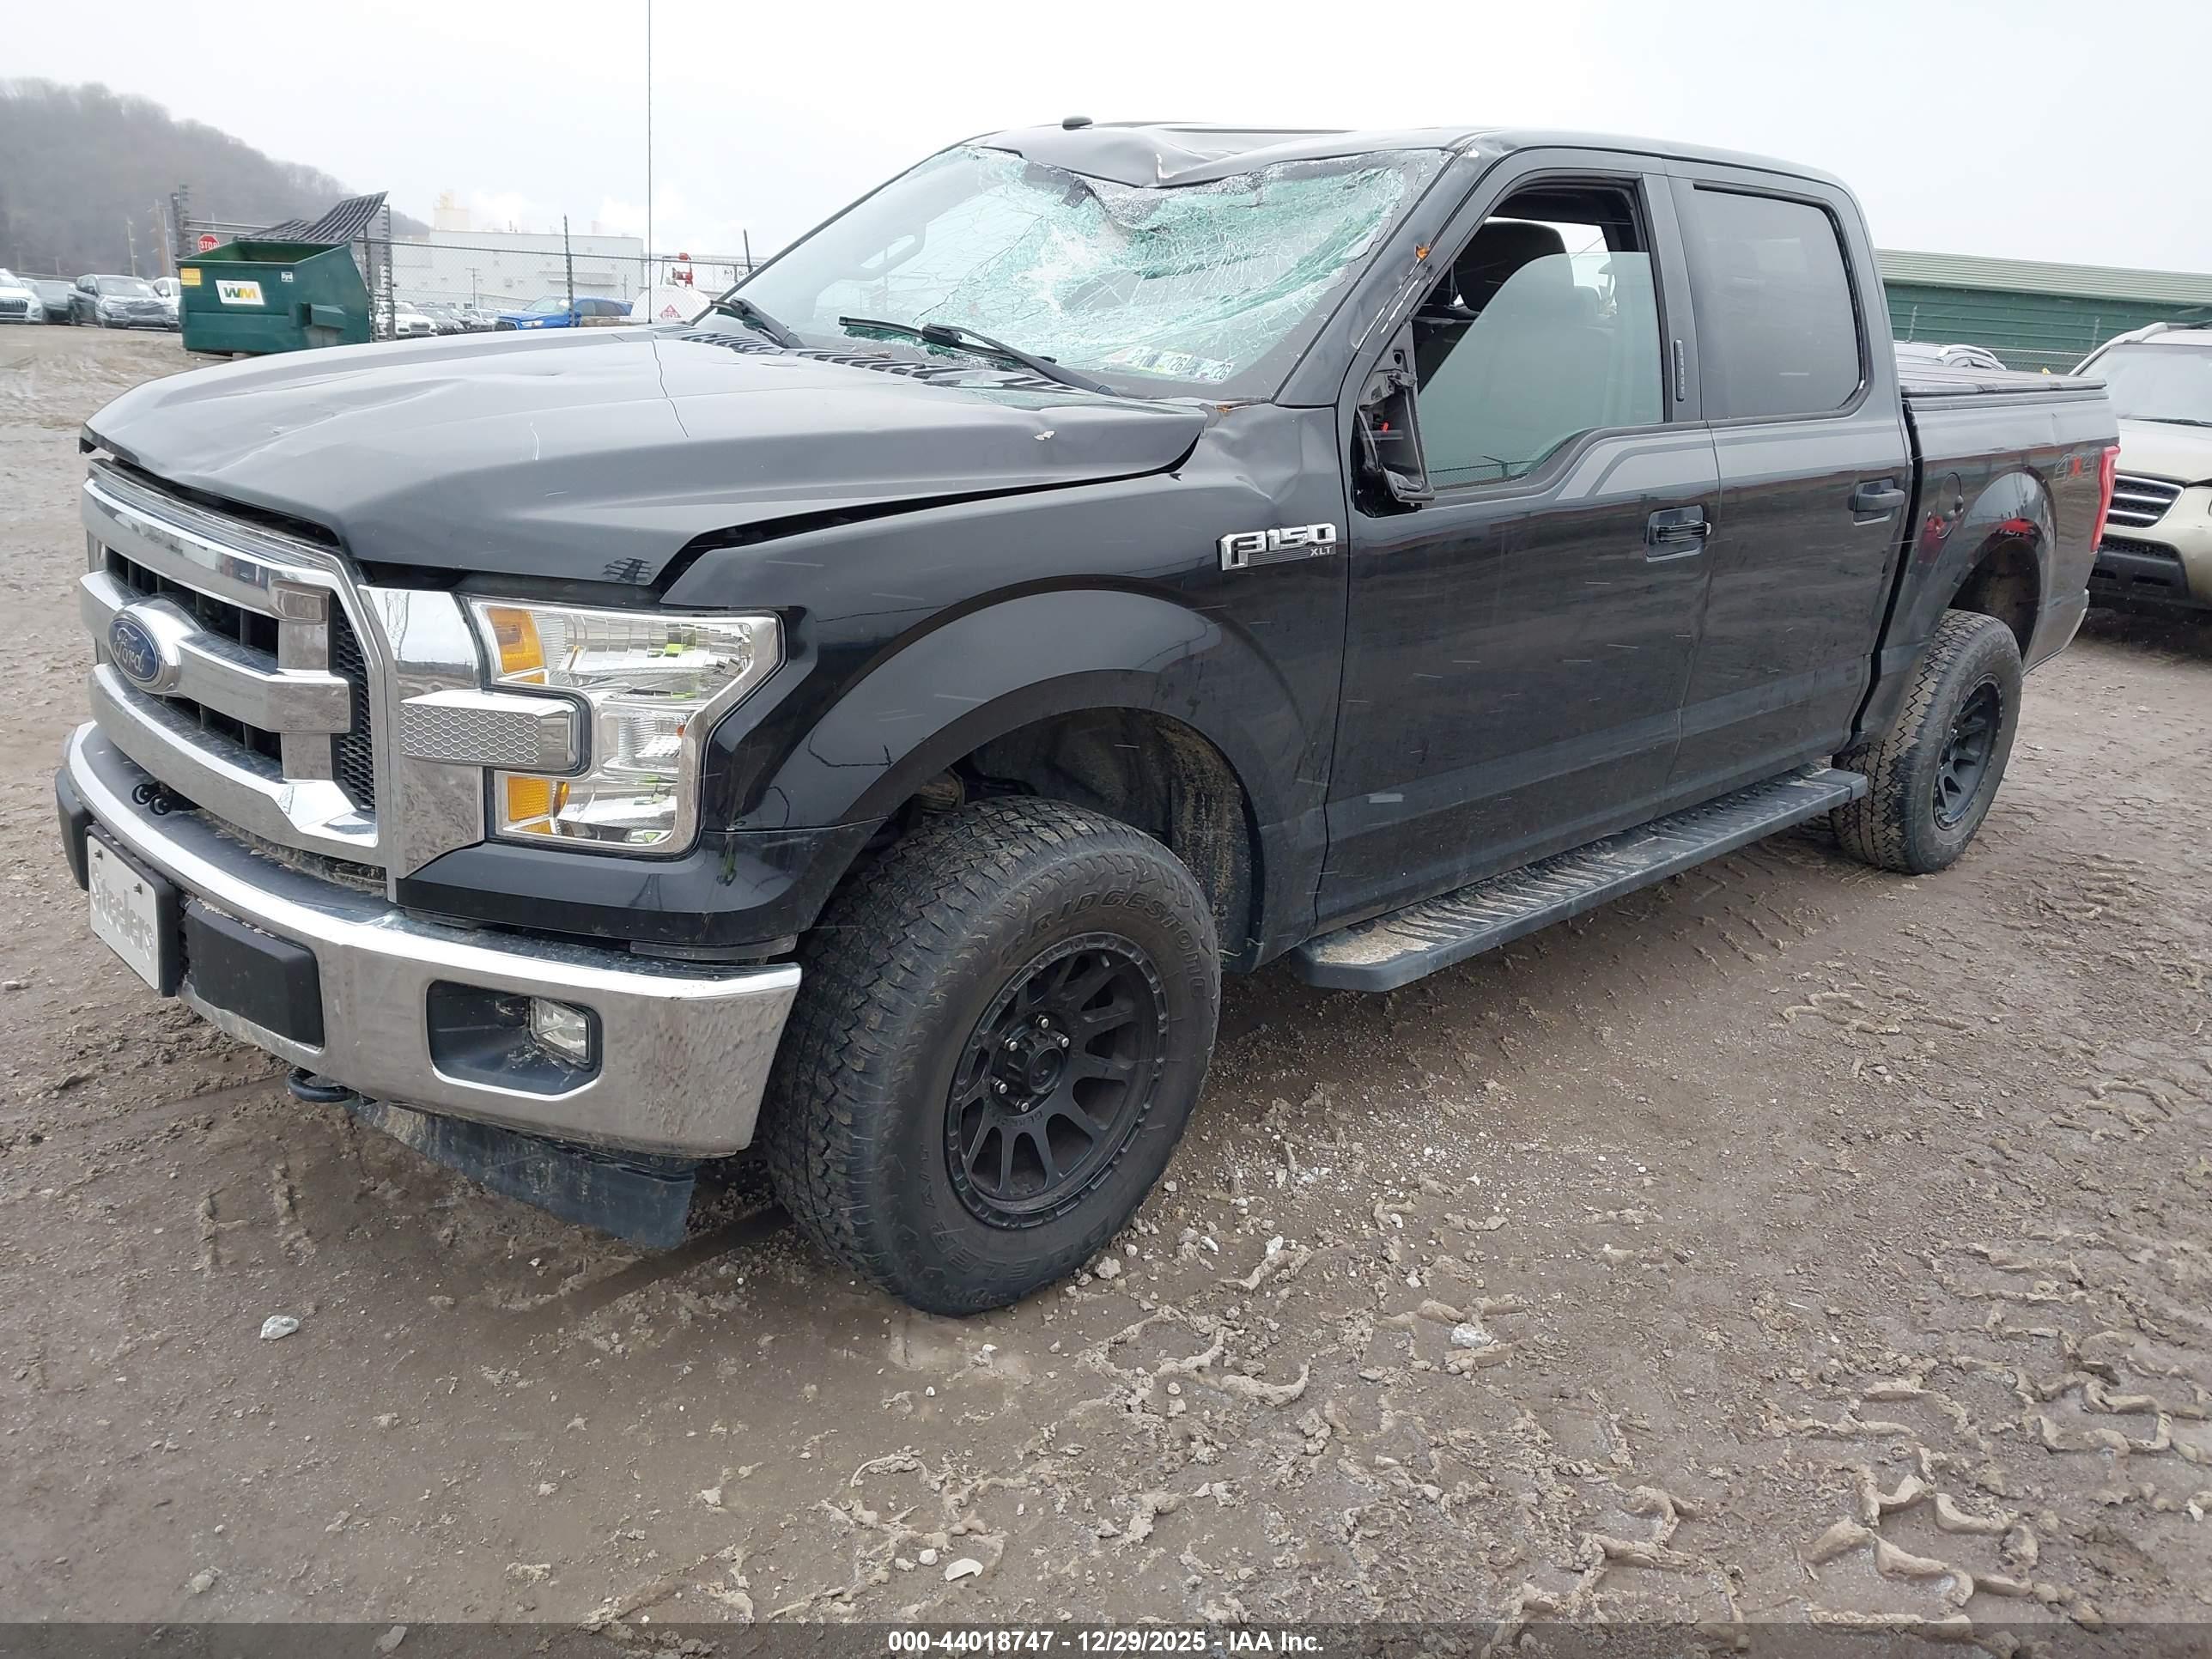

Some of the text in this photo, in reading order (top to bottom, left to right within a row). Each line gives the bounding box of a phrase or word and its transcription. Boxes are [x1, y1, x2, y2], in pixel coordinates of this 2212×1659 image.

[198, 240, 218, 250] STOP
[222, 287, 258, 300] WM
[1310, 544, 1334, 557] XLT
[113, 626, 145, 673] Ford
[1000, 890, 1206, 1000] BRIDGESTONE
